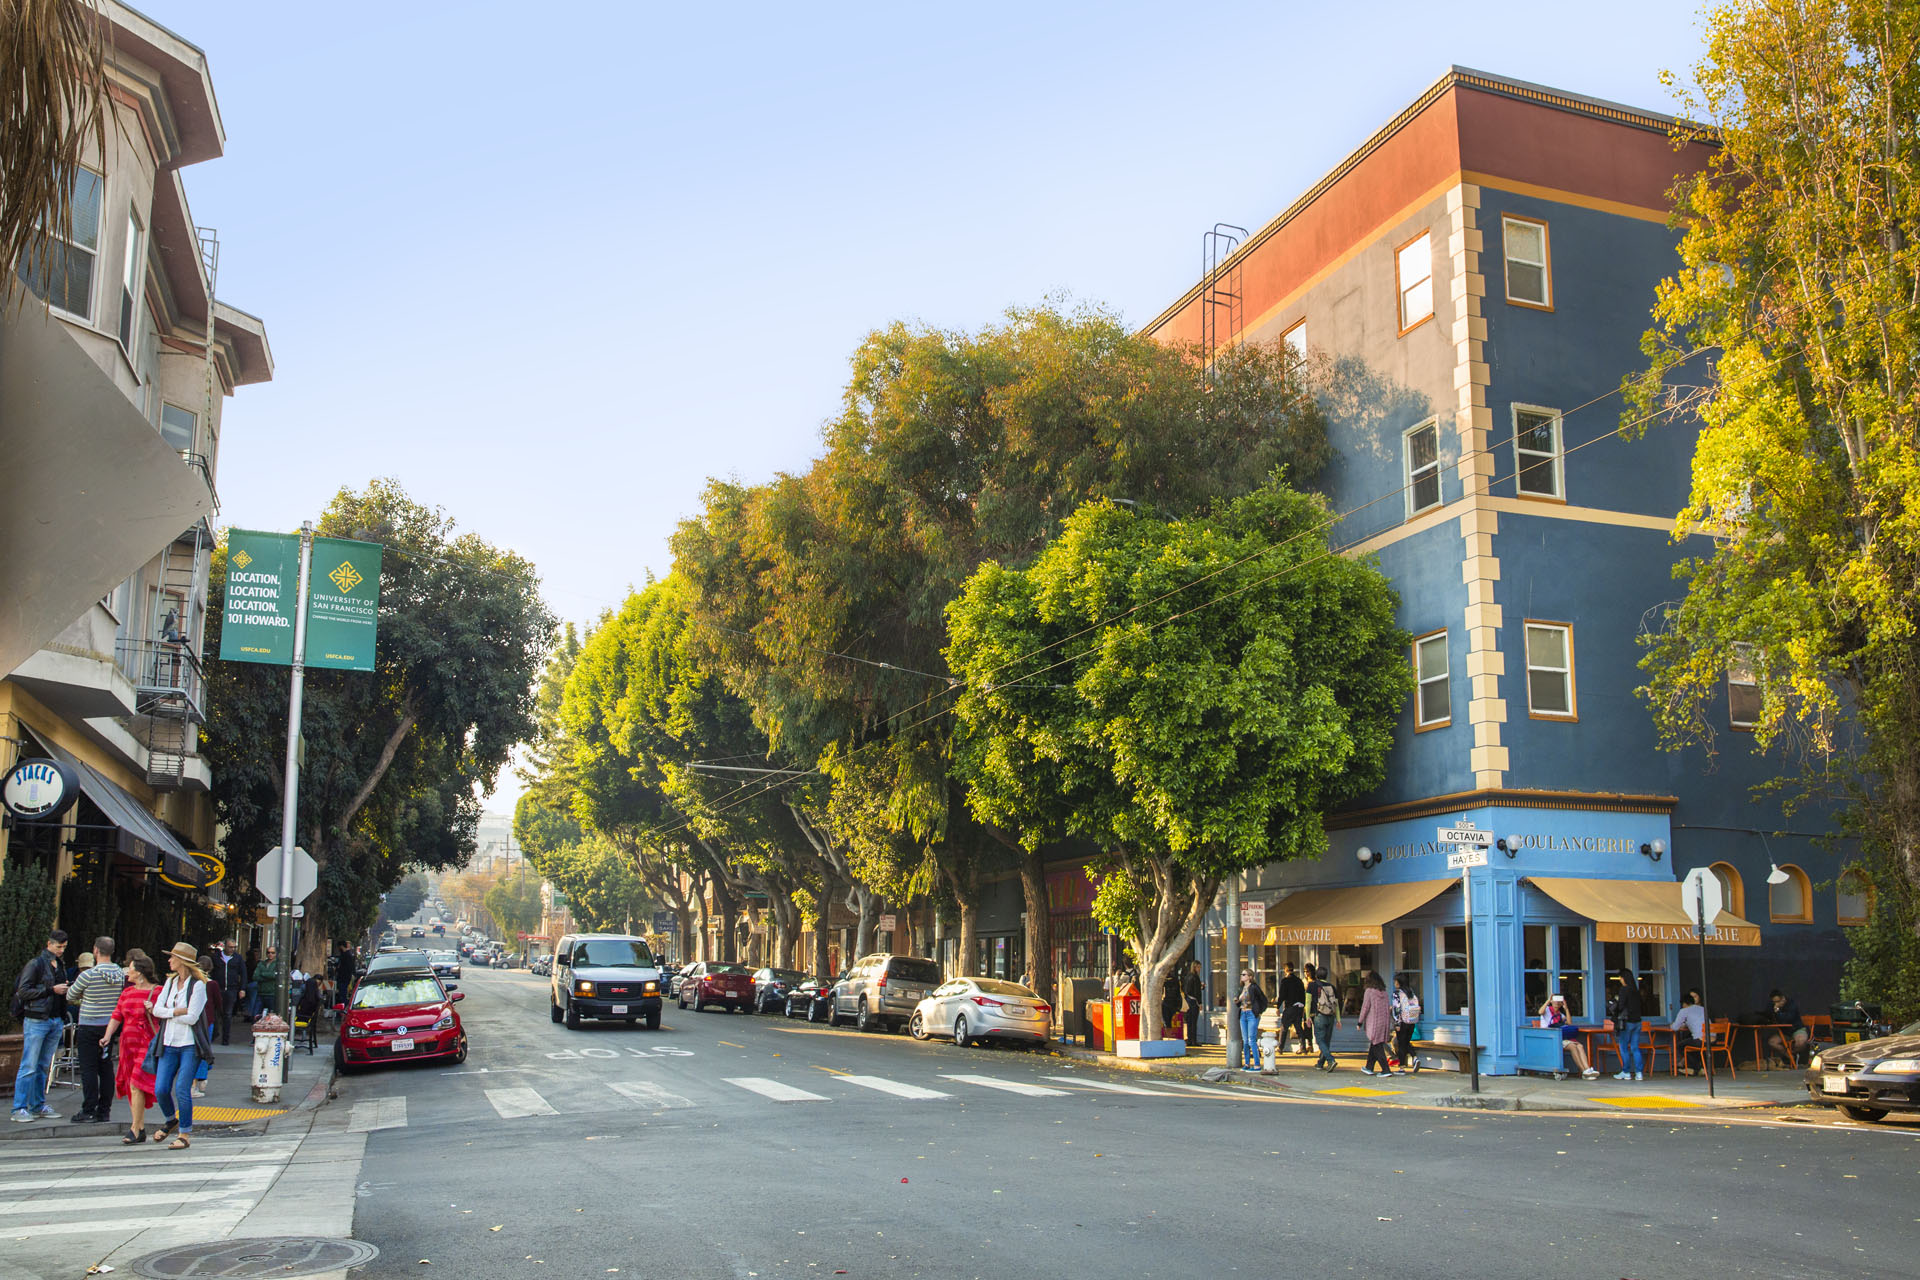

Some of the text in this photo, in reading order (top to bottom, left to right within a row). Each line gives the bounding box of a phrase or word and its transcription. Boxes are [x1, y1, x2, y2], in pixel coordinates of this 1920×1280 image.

[231, 571, 281, 585] LOCATION.
[230, 586, 279, 599] LOCATION.
[313, 593, 361, 605] UNIVERSITY
[229, 600, 278, 613] LOCATION.
[313, 601, 374, 615] SAN FRANCISCO
[228, 613, 291, 628] 101 HOWARD.
[240, 646, 271, 654] USFCA.EDU
[325, 653, 355, 661] USFCA.EDU
[15, 764, 55, 785] STACKS
[1446, 831, 1485, 842] OCTAVIA
[1452, 853, 1481, 865] HAYES
[544, 1046, 695, 1060] STOP
